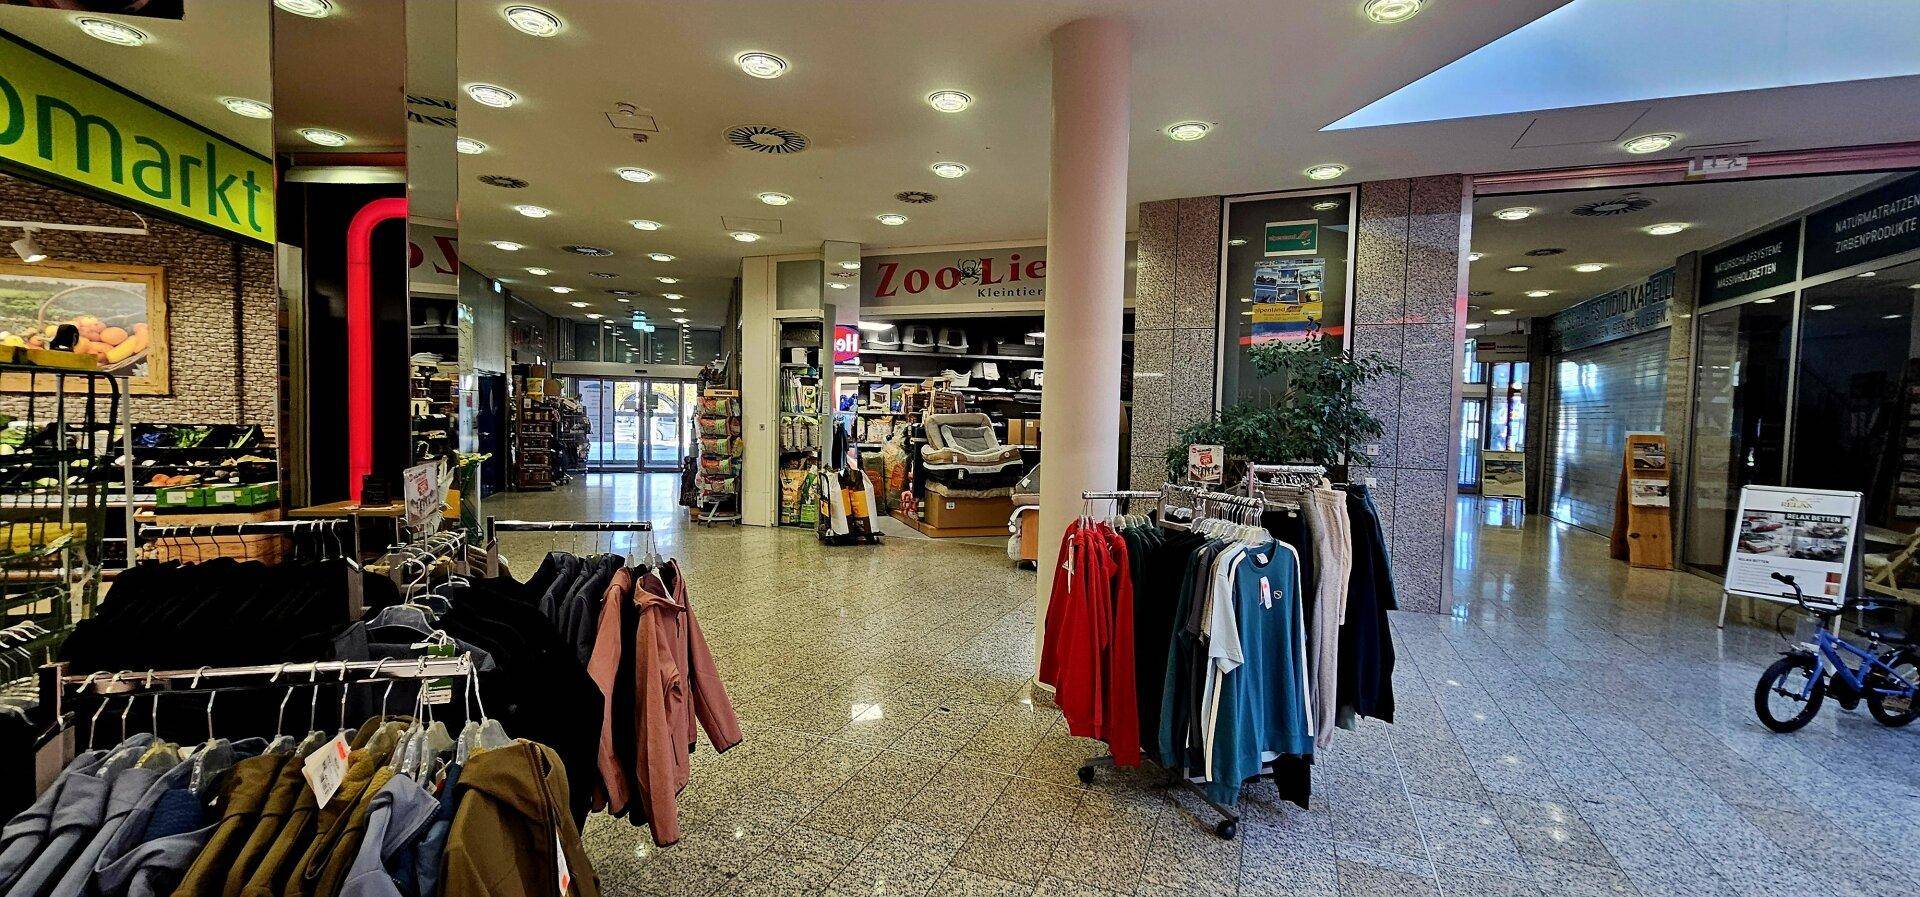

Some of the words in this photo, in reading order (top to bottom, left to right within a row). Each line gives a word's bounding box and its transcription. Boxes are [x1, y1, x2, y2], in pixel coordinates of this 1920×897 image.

[1835, 194, 1920, 233] NATURMATRATZEN
[1835, 217, 1917, 253] ZIRBENPRODUKTE
[875, 262, 962, 298] Zoo
[977, 287, 1044, 298] Kleintier
[1786, 513, 1811, 521] RELAX
[1811, 514, 1841, 523] BETTEN
